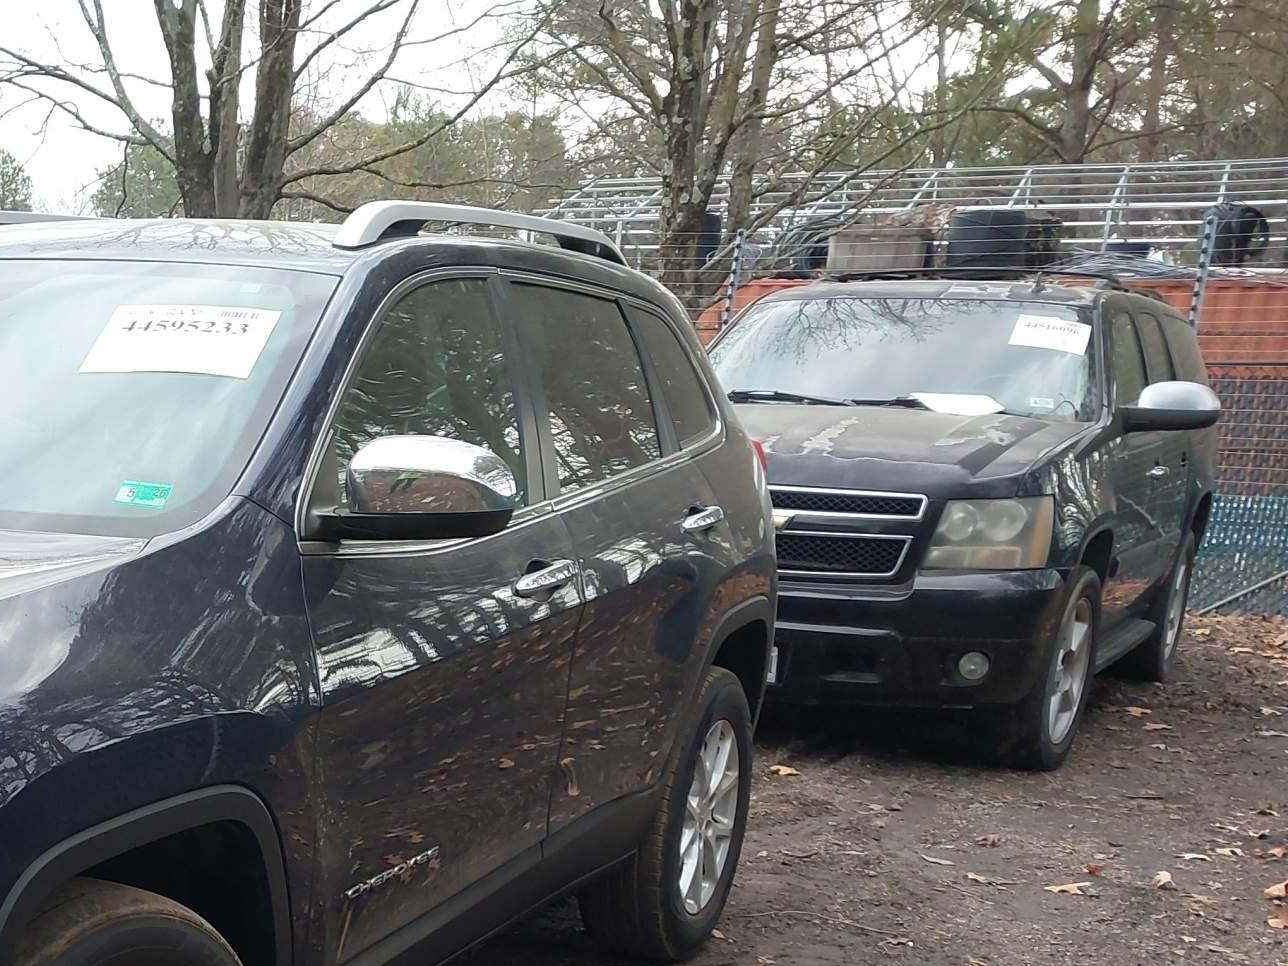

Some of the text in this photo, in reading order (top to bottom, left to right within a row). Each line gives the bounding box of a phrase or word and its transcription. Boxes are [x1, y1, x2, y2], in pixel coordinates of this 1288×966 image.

[121, 319, 250, 335] 44595233
[126, 487, 169, 499] 5 26
[345, 845, 441, 899] CHEROKEE
